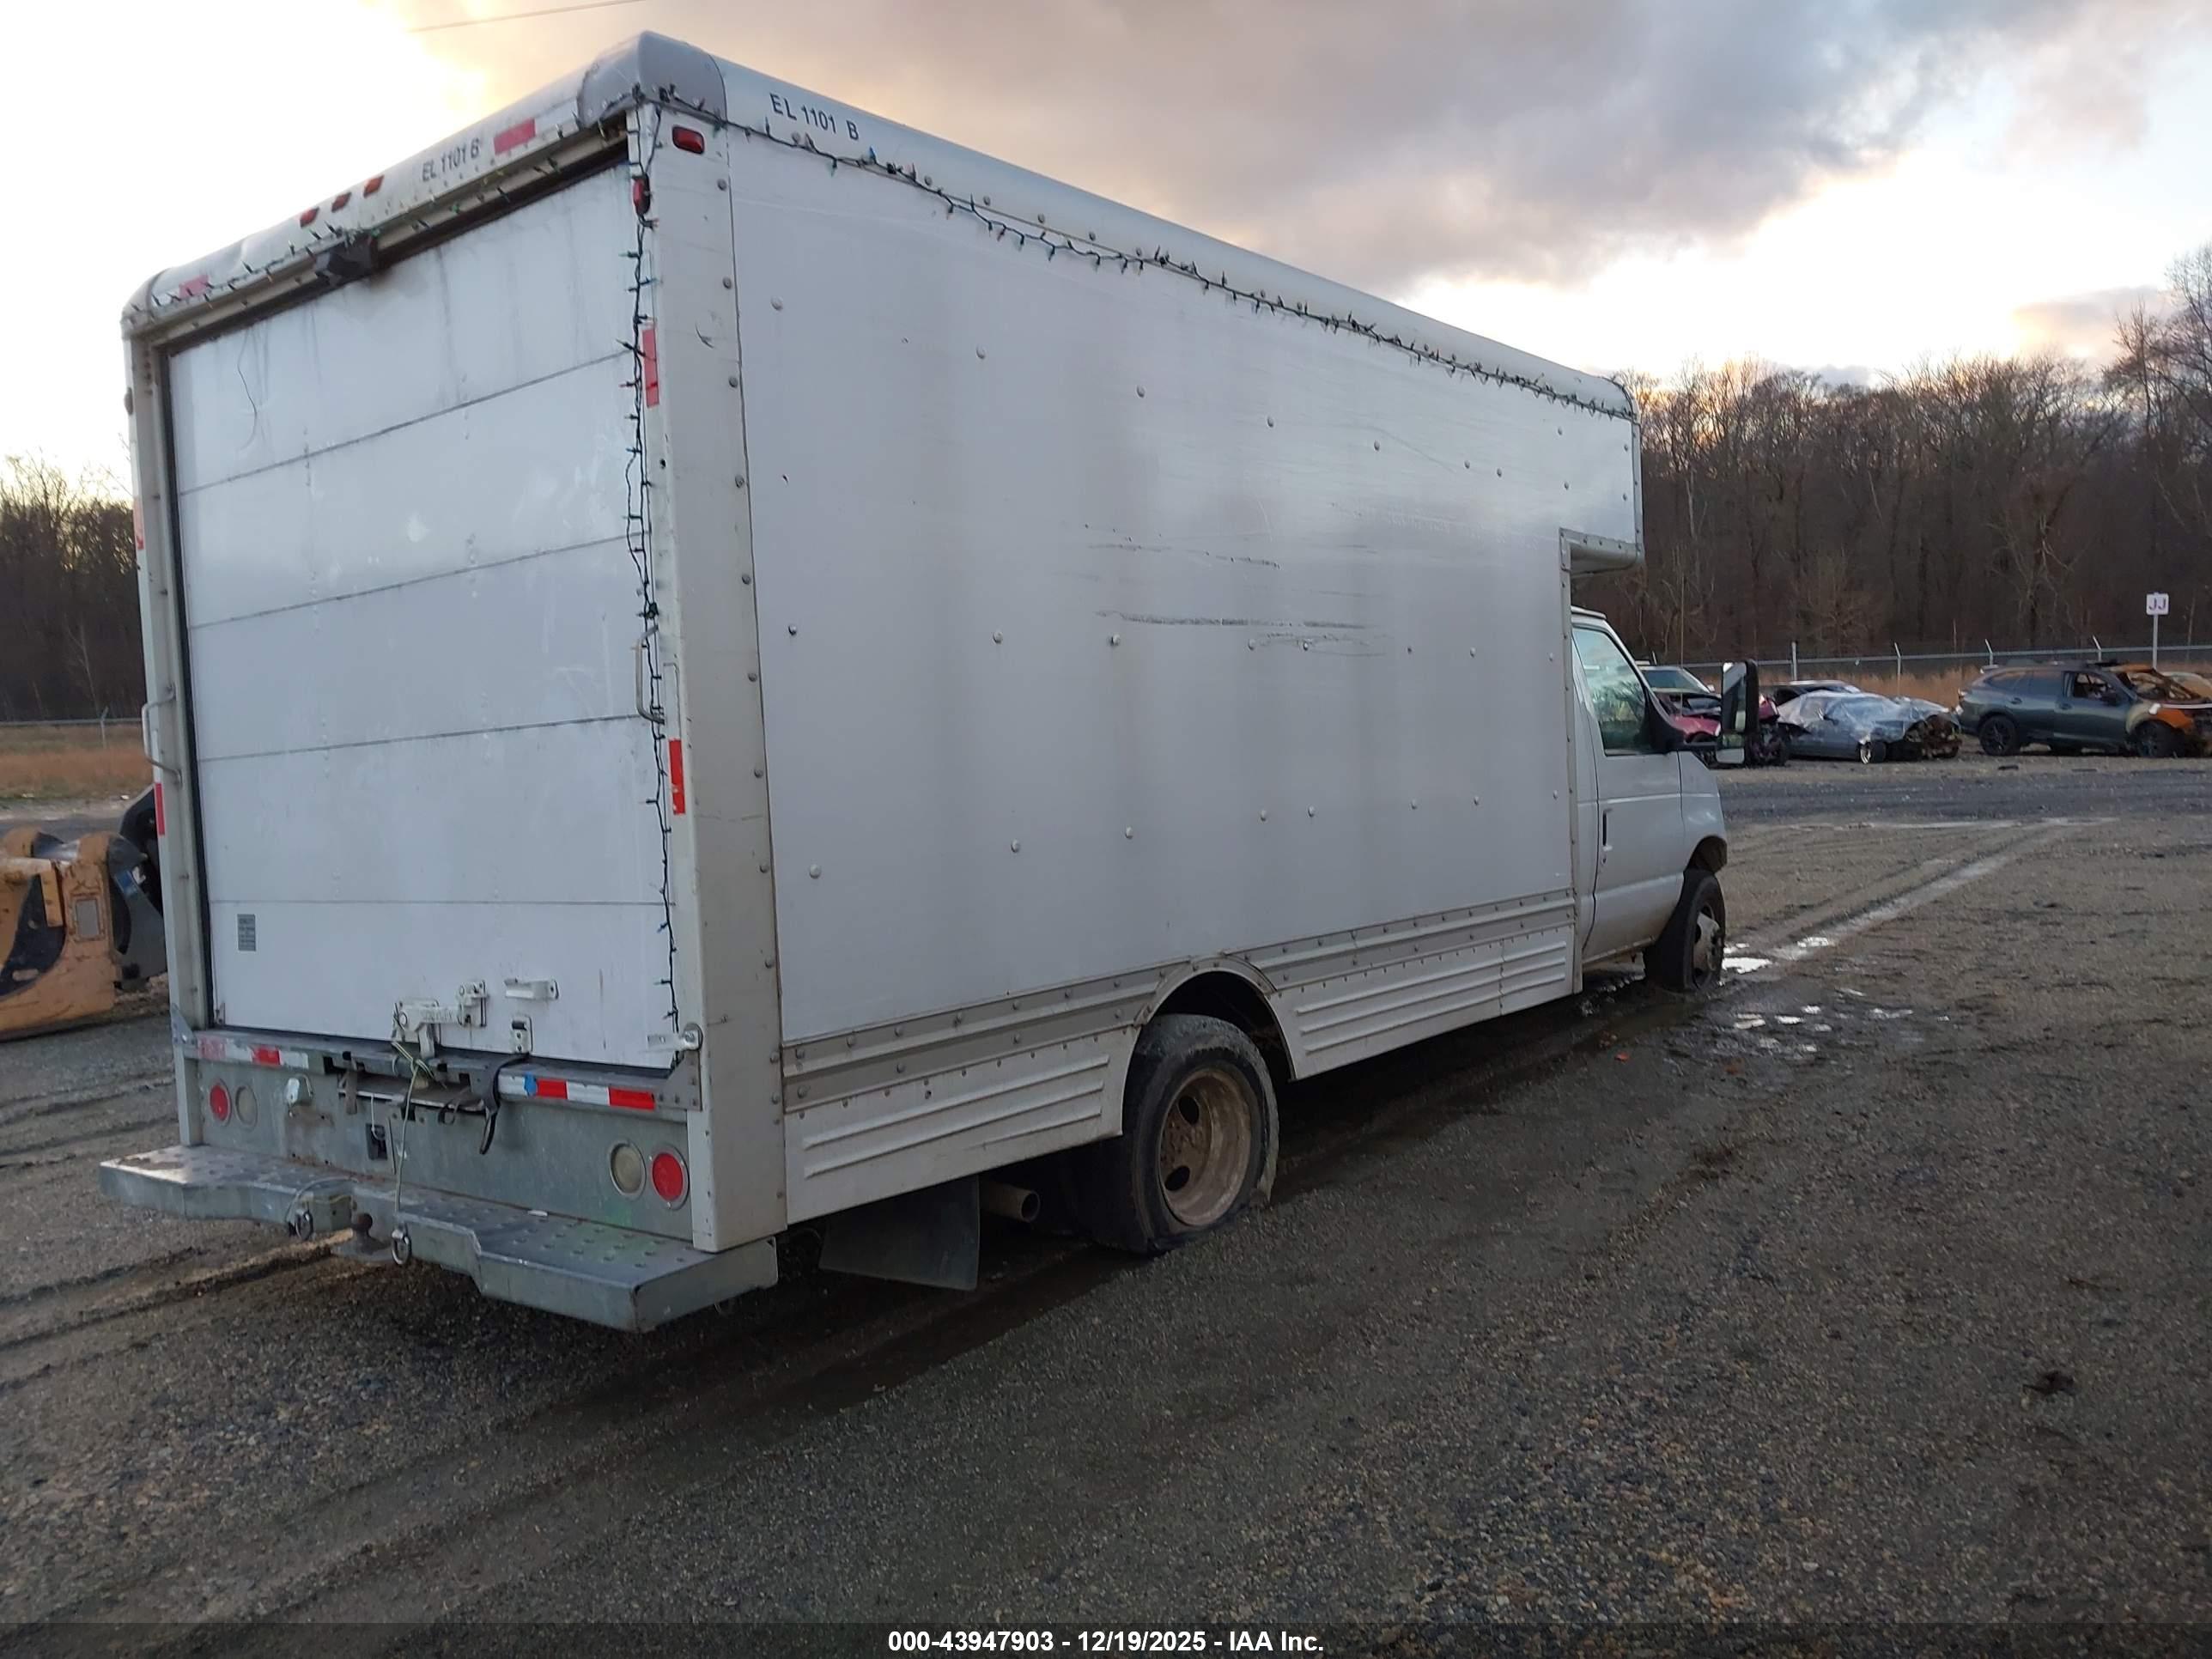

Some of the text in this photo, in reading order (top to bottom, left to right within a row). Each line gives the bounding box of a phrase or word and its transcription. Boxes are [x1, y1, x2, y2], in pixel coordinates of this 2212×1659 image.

[769, 93, 859, 141] EL 1101 B
[422, 160, 436, 182] EL
[441, 144, 466, 173] 1101
[2148, 598, 2166, 611] JJ
